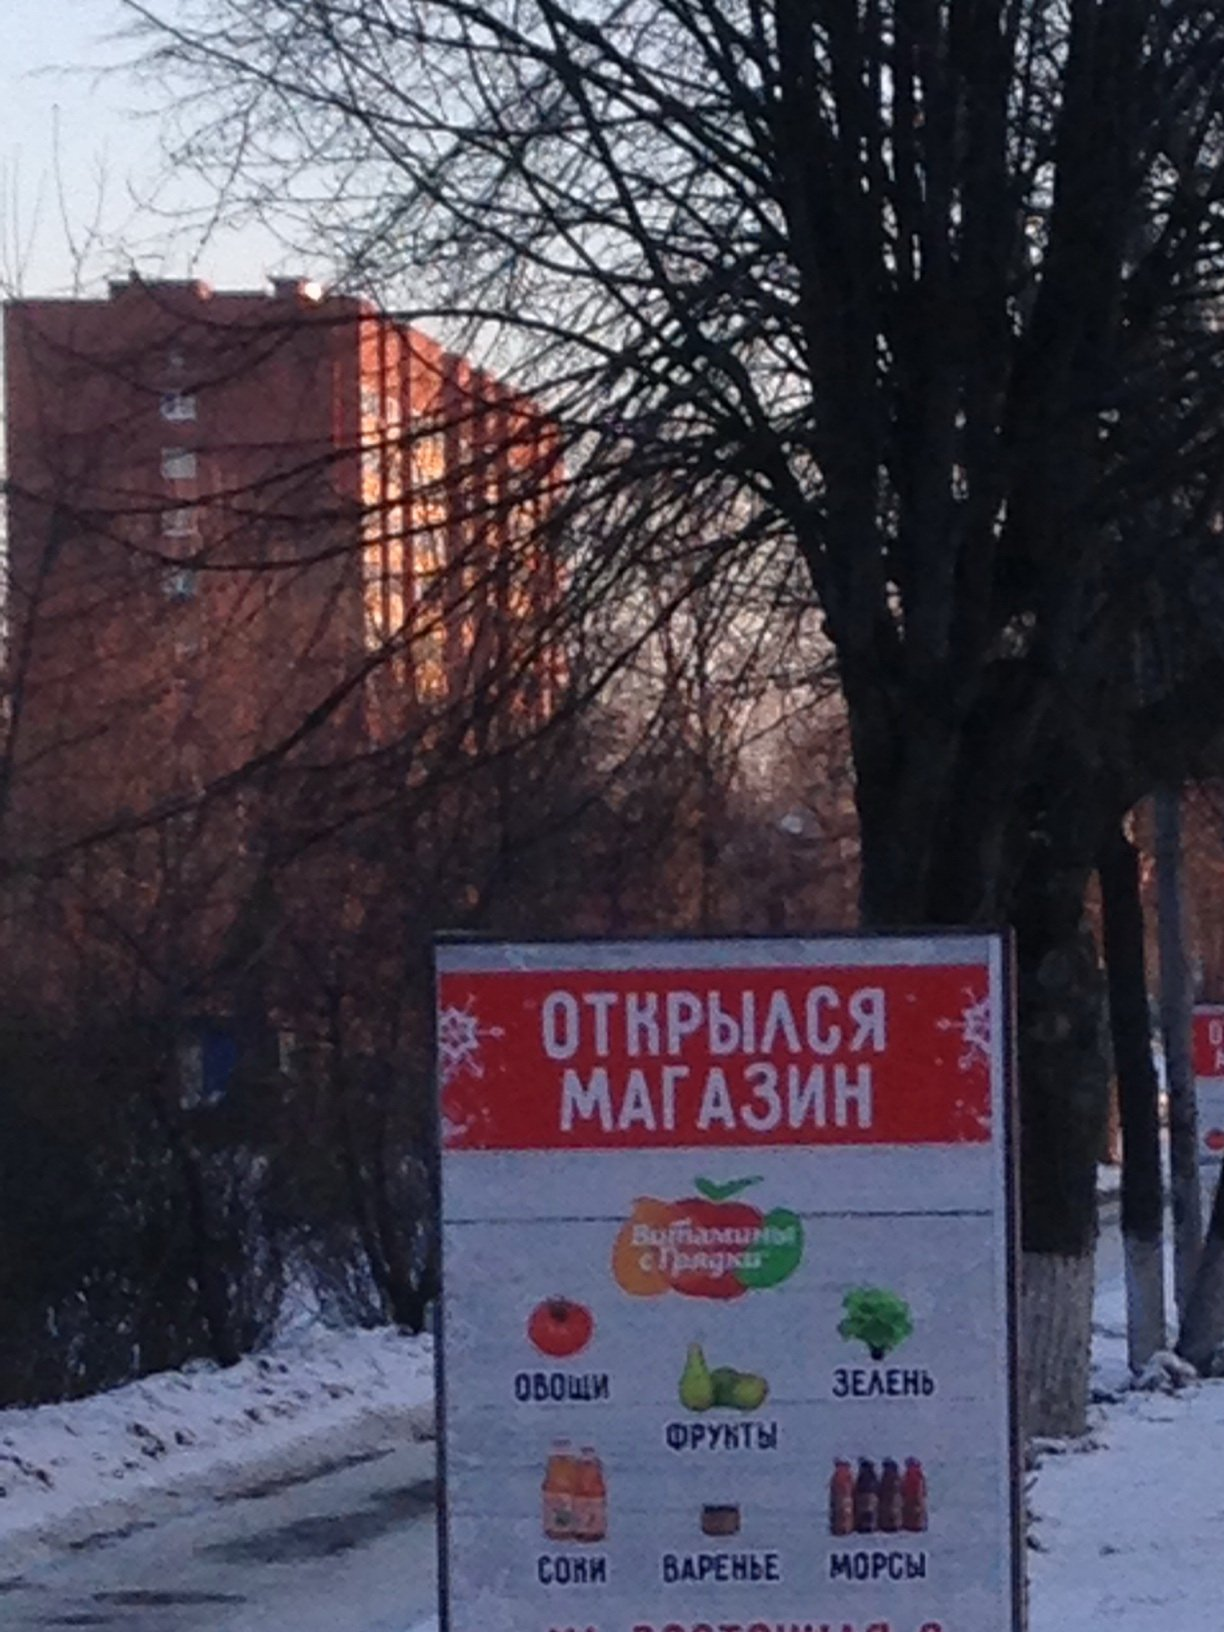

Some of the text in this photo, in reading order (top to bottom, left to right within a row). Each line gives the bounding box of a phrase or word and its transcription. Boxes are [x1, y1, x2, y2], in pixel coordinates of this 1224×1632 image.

[541, 986, 887, 1059] ОТКРЫЛСЯ
[559, 1063, 873, 1132] МАГАЗИН
[514, 1373, 609, 1401] ОВОЩИ
[832, 1368, 935, 1398] ЗЕЛЕНЬ
[665, 1421, 778, 1450] ФРУКТЫ
[538, 1556, 607, 1584] СОКИ
[663, 1553, 780, 1582] ВАРЕНЬЕ
[830, 1551, 926, 1580] МОРСЫ
